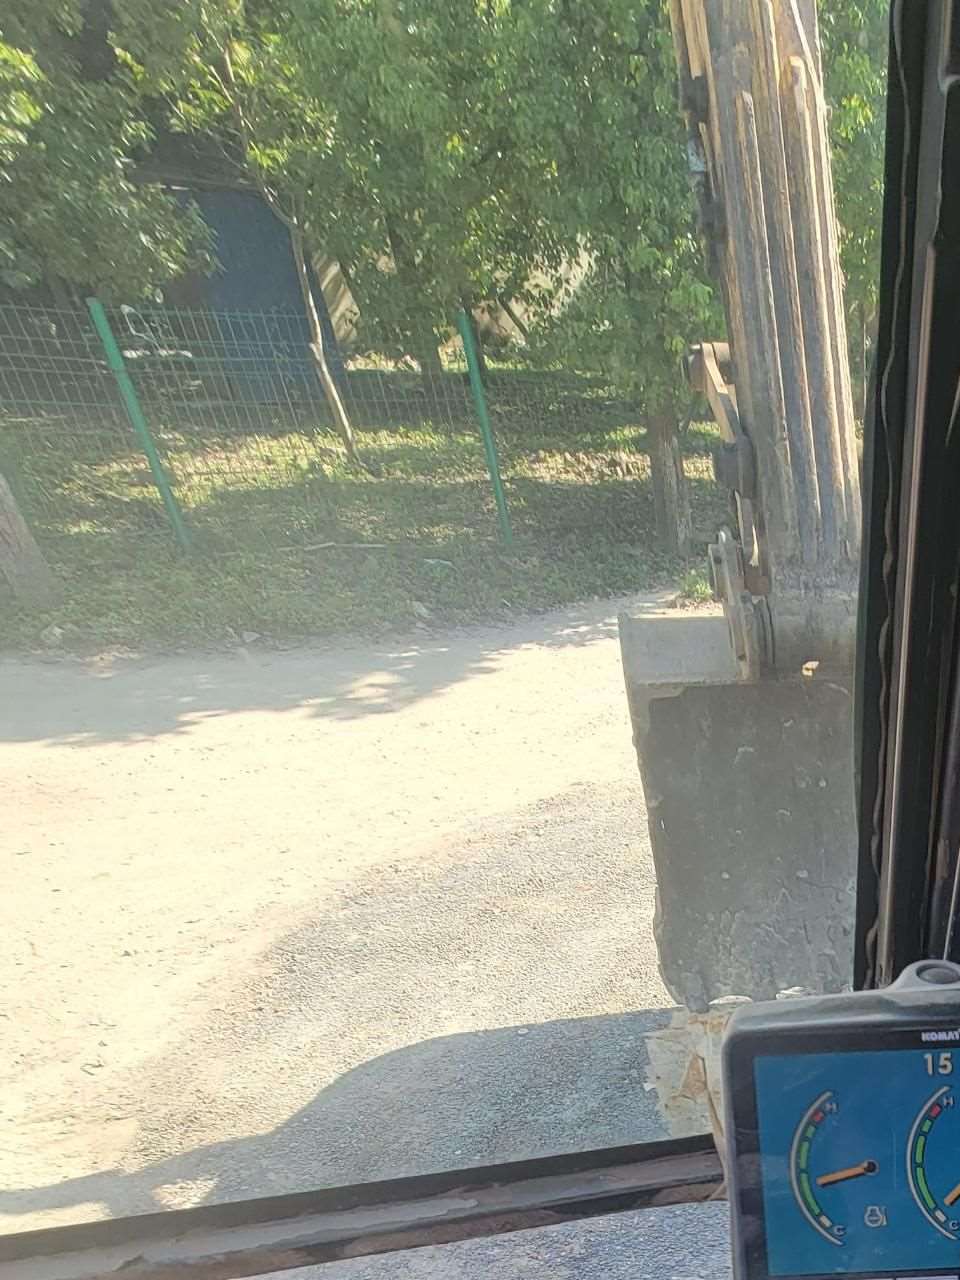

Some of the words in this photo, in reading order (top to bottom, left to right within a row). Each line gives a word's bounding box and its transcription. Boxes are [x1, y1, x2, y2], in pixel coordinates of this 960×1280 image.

[923, 1053, 953, 1075] 15
[825, 1102, 838, 1113] H
[943, 1097, 955, 1108] H
